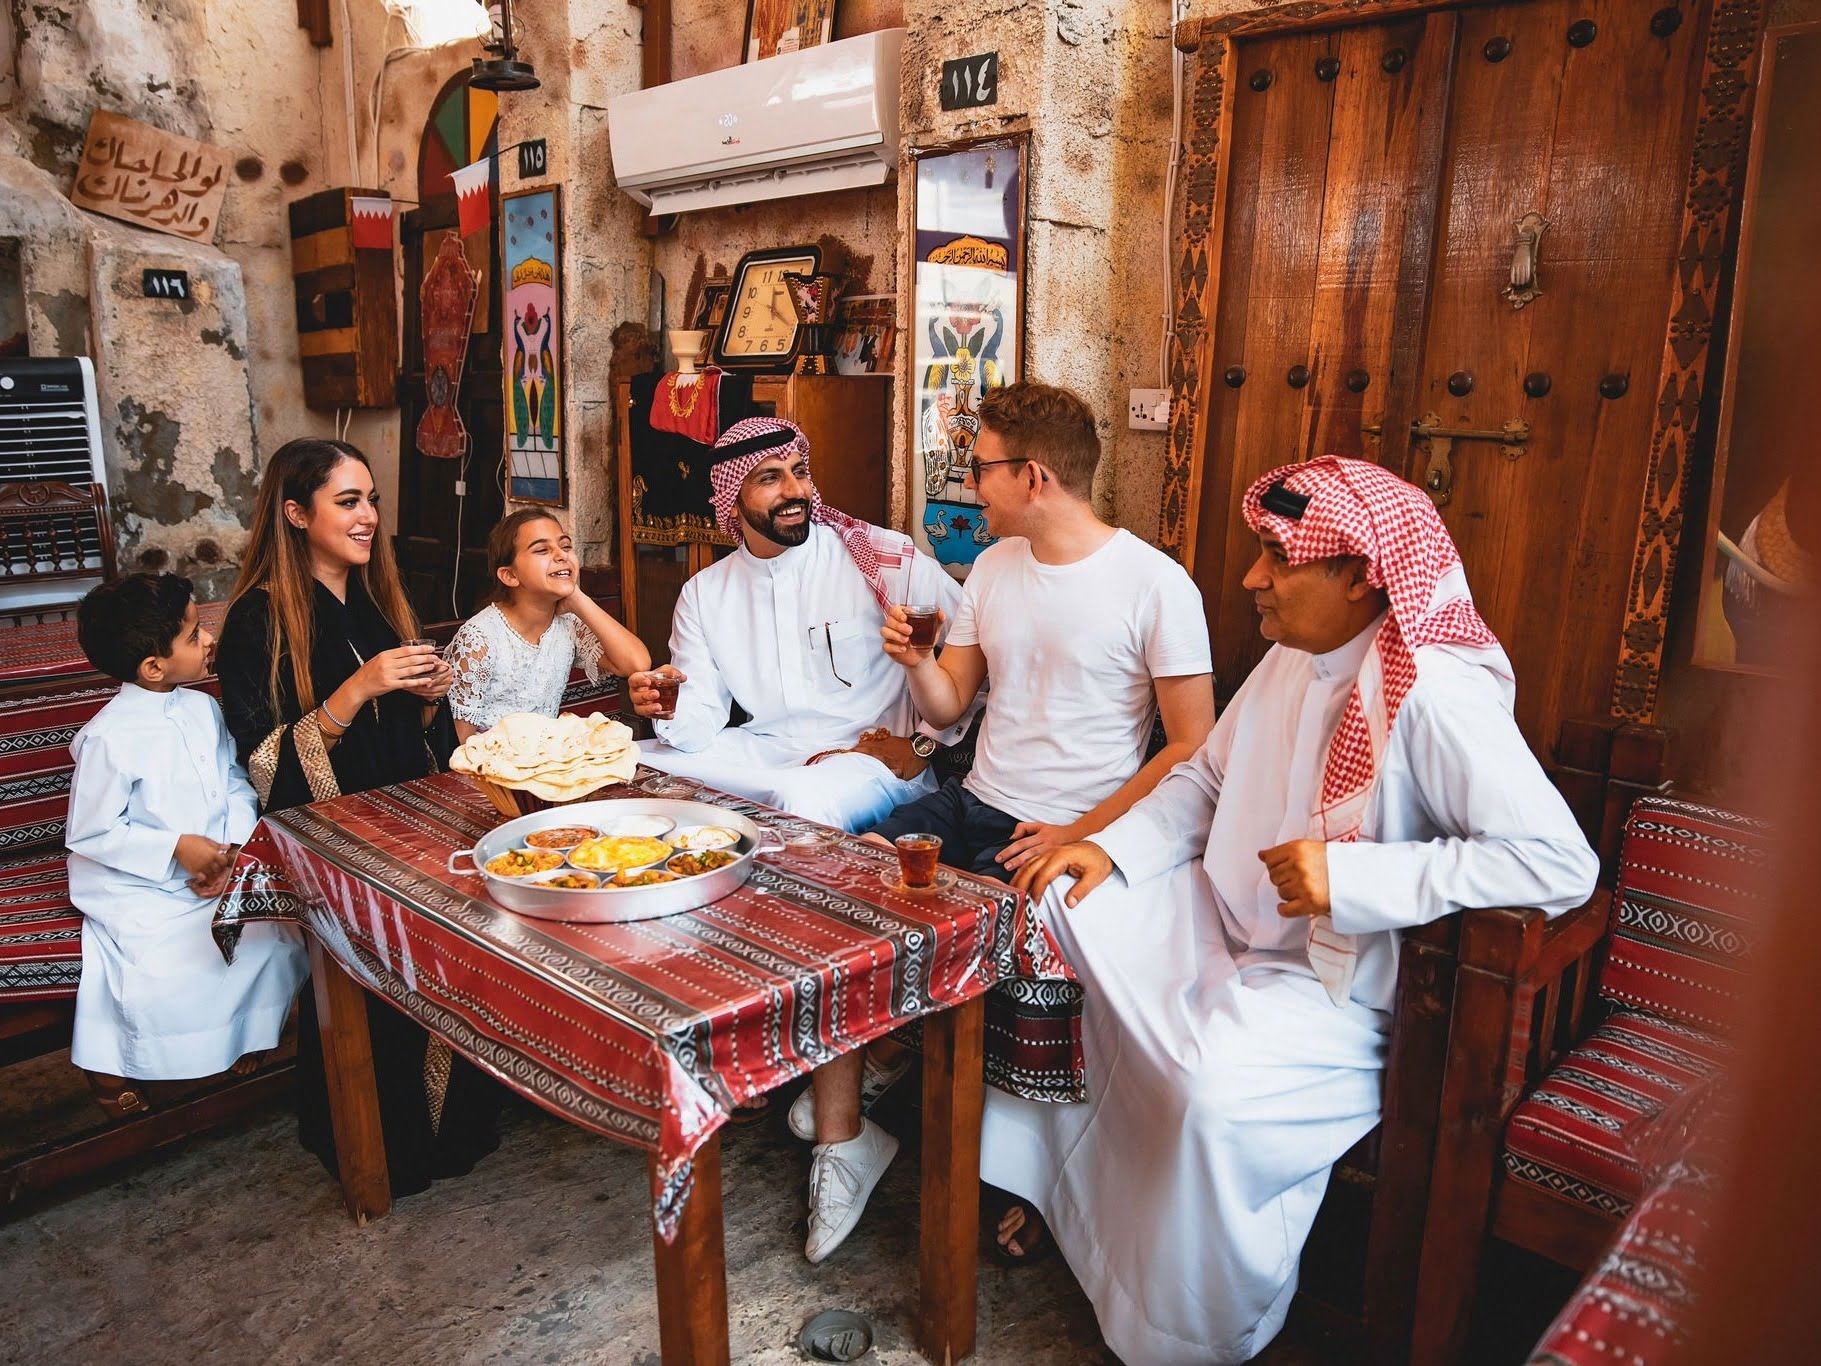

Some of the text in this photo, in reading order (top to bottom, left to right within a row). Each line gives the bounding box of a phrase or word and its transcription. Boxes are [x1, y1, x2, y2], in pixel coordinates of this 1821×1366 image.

[952, 58, 991, 101] ١١٤
[524, 145, 543, 170] ١١٥
[974, 247, 990, 264] الله
[762, 270, 773, 284] 11
[747, 287, 758, 299] 10
[742, 306, 751, 319] 9
[738, 325, 747, 338] 8
[744, 340, 753, 353] 7
[760, 339, 769, 352] 6
[776, 339, 786, 352] 5
